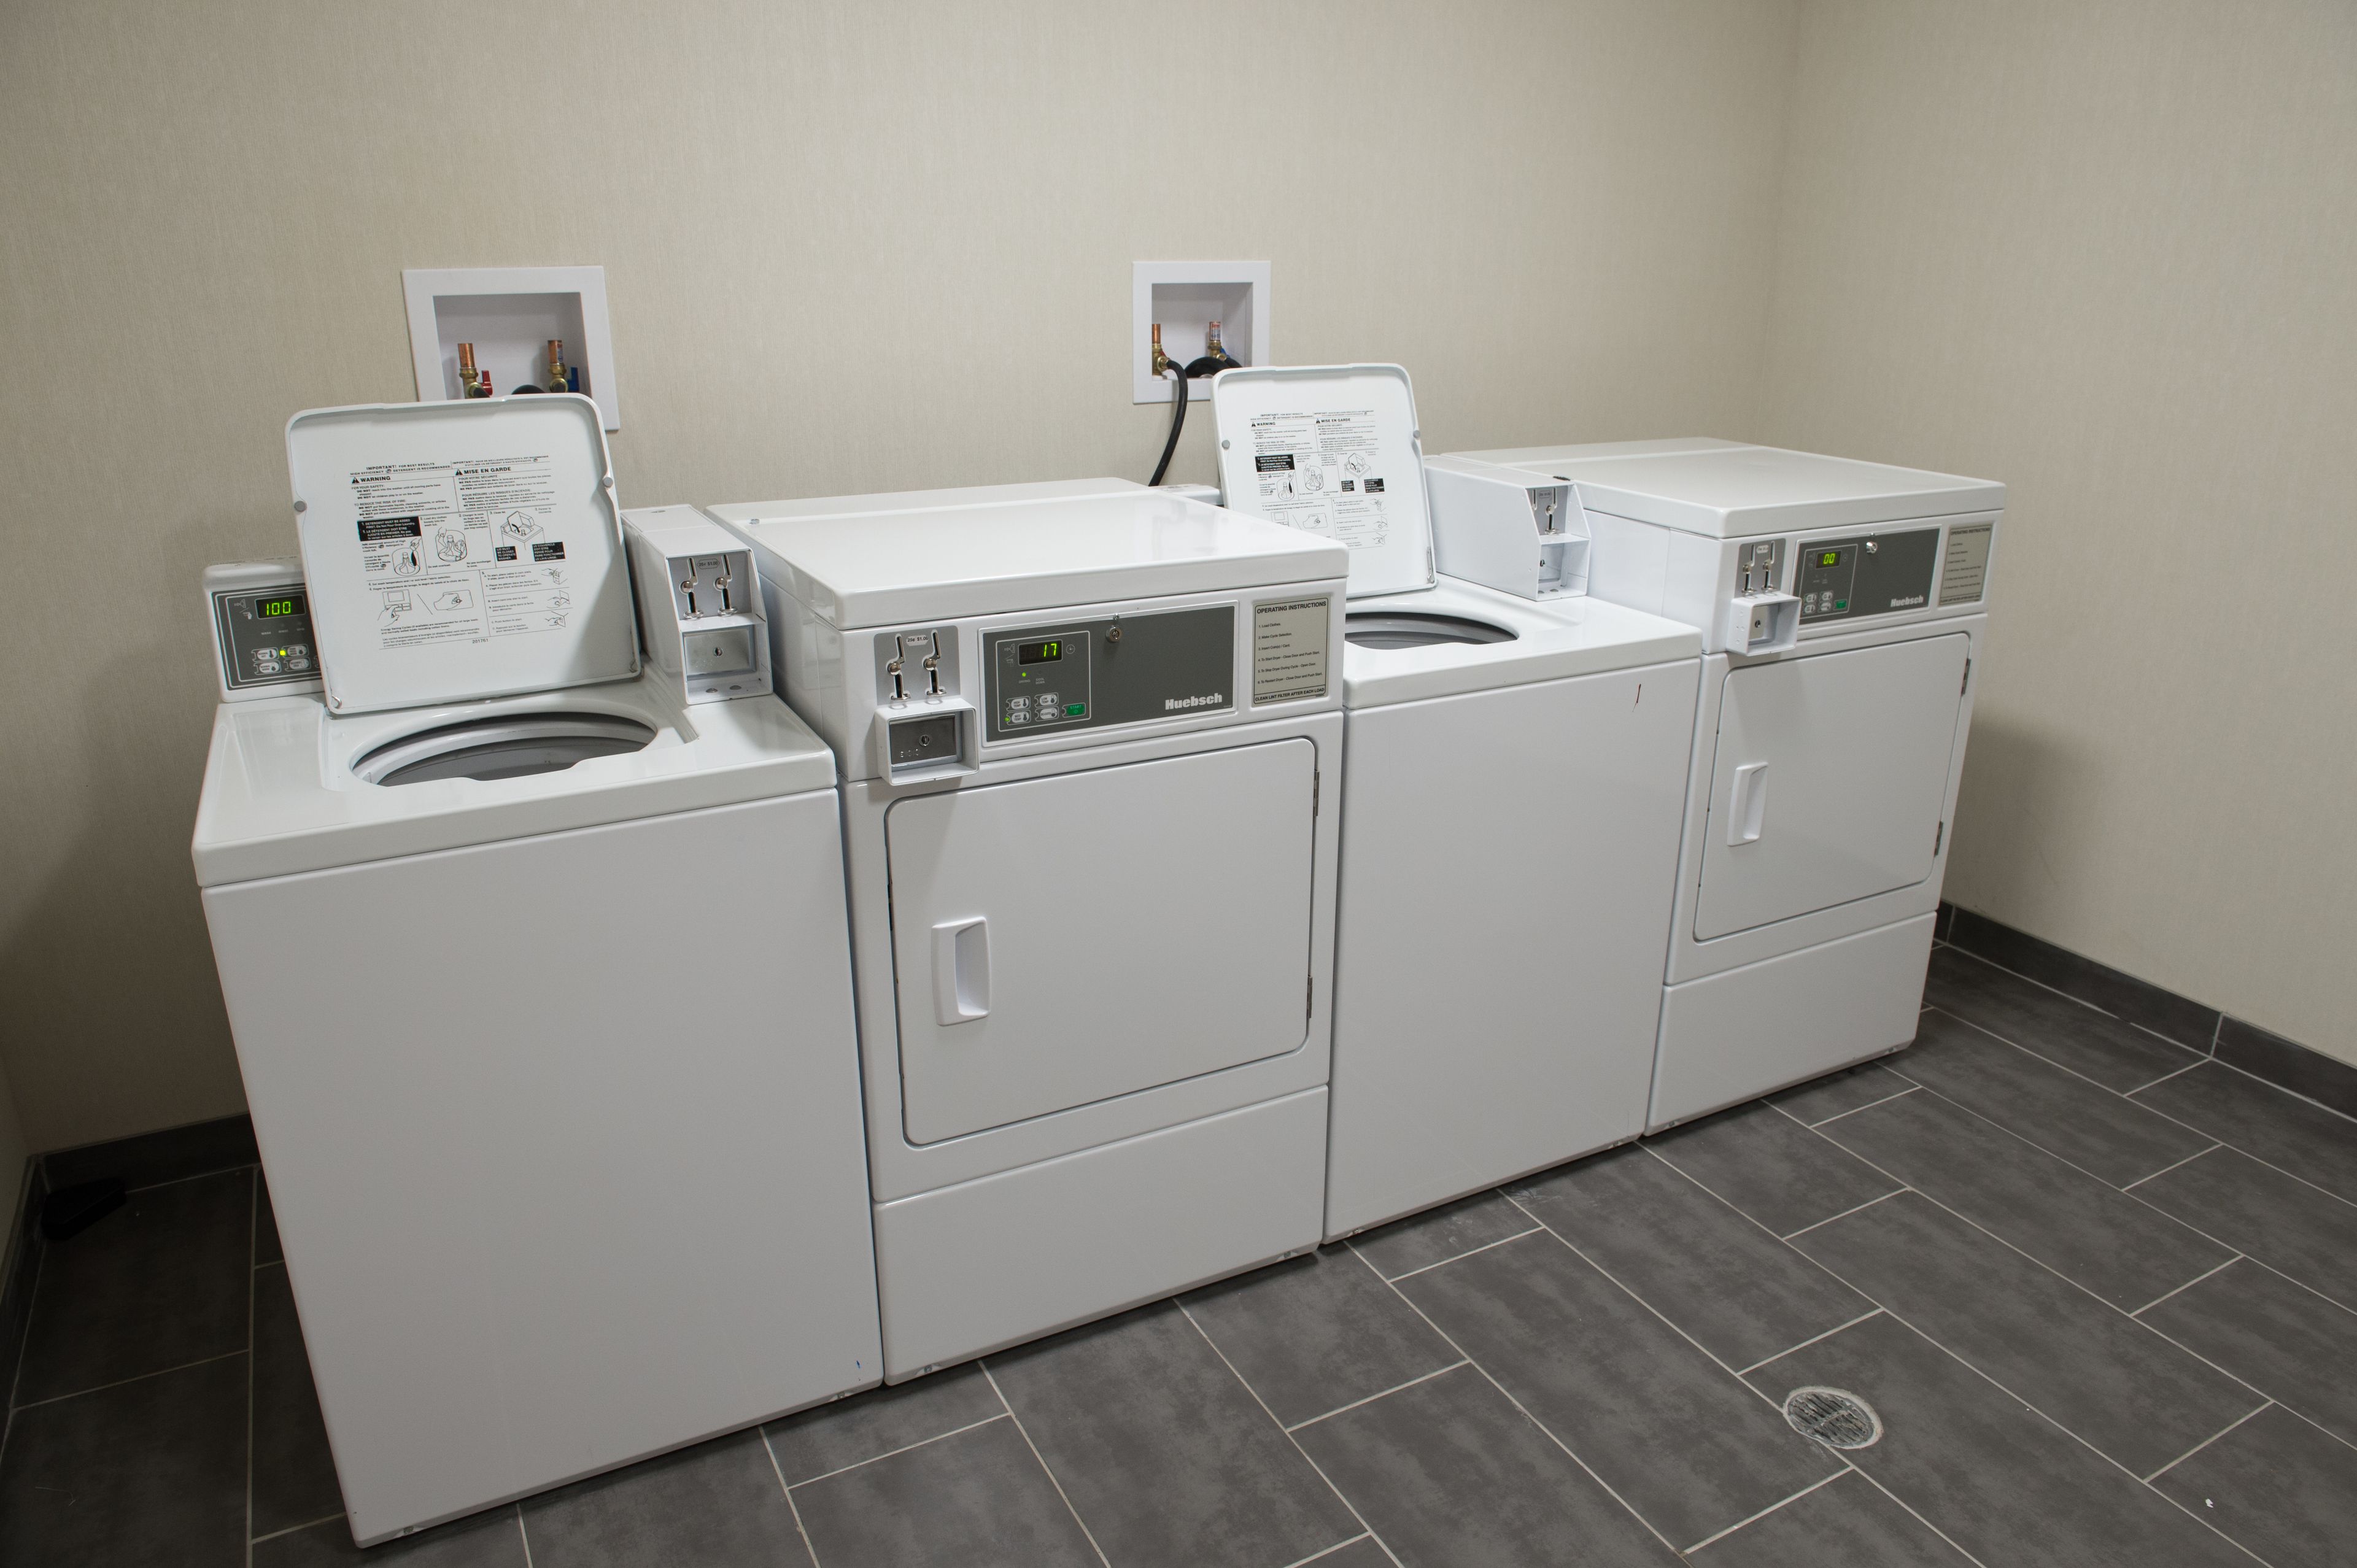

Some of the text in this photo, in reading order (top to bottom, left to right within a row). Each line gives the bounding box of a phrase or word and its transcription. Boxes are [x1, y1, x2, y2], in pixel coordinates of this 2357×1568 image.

[1823, 553, 1836, 564] 00
[1257, 601, 1326, 614] OPERATING INSTRUCTIONS
[1891, 595, 1923, 607] Huebsch
[266, 601, 291, 616] 100
[1043, 643, 1057, 657] 17
[1165, 693, 1223, 710] Huebsch
